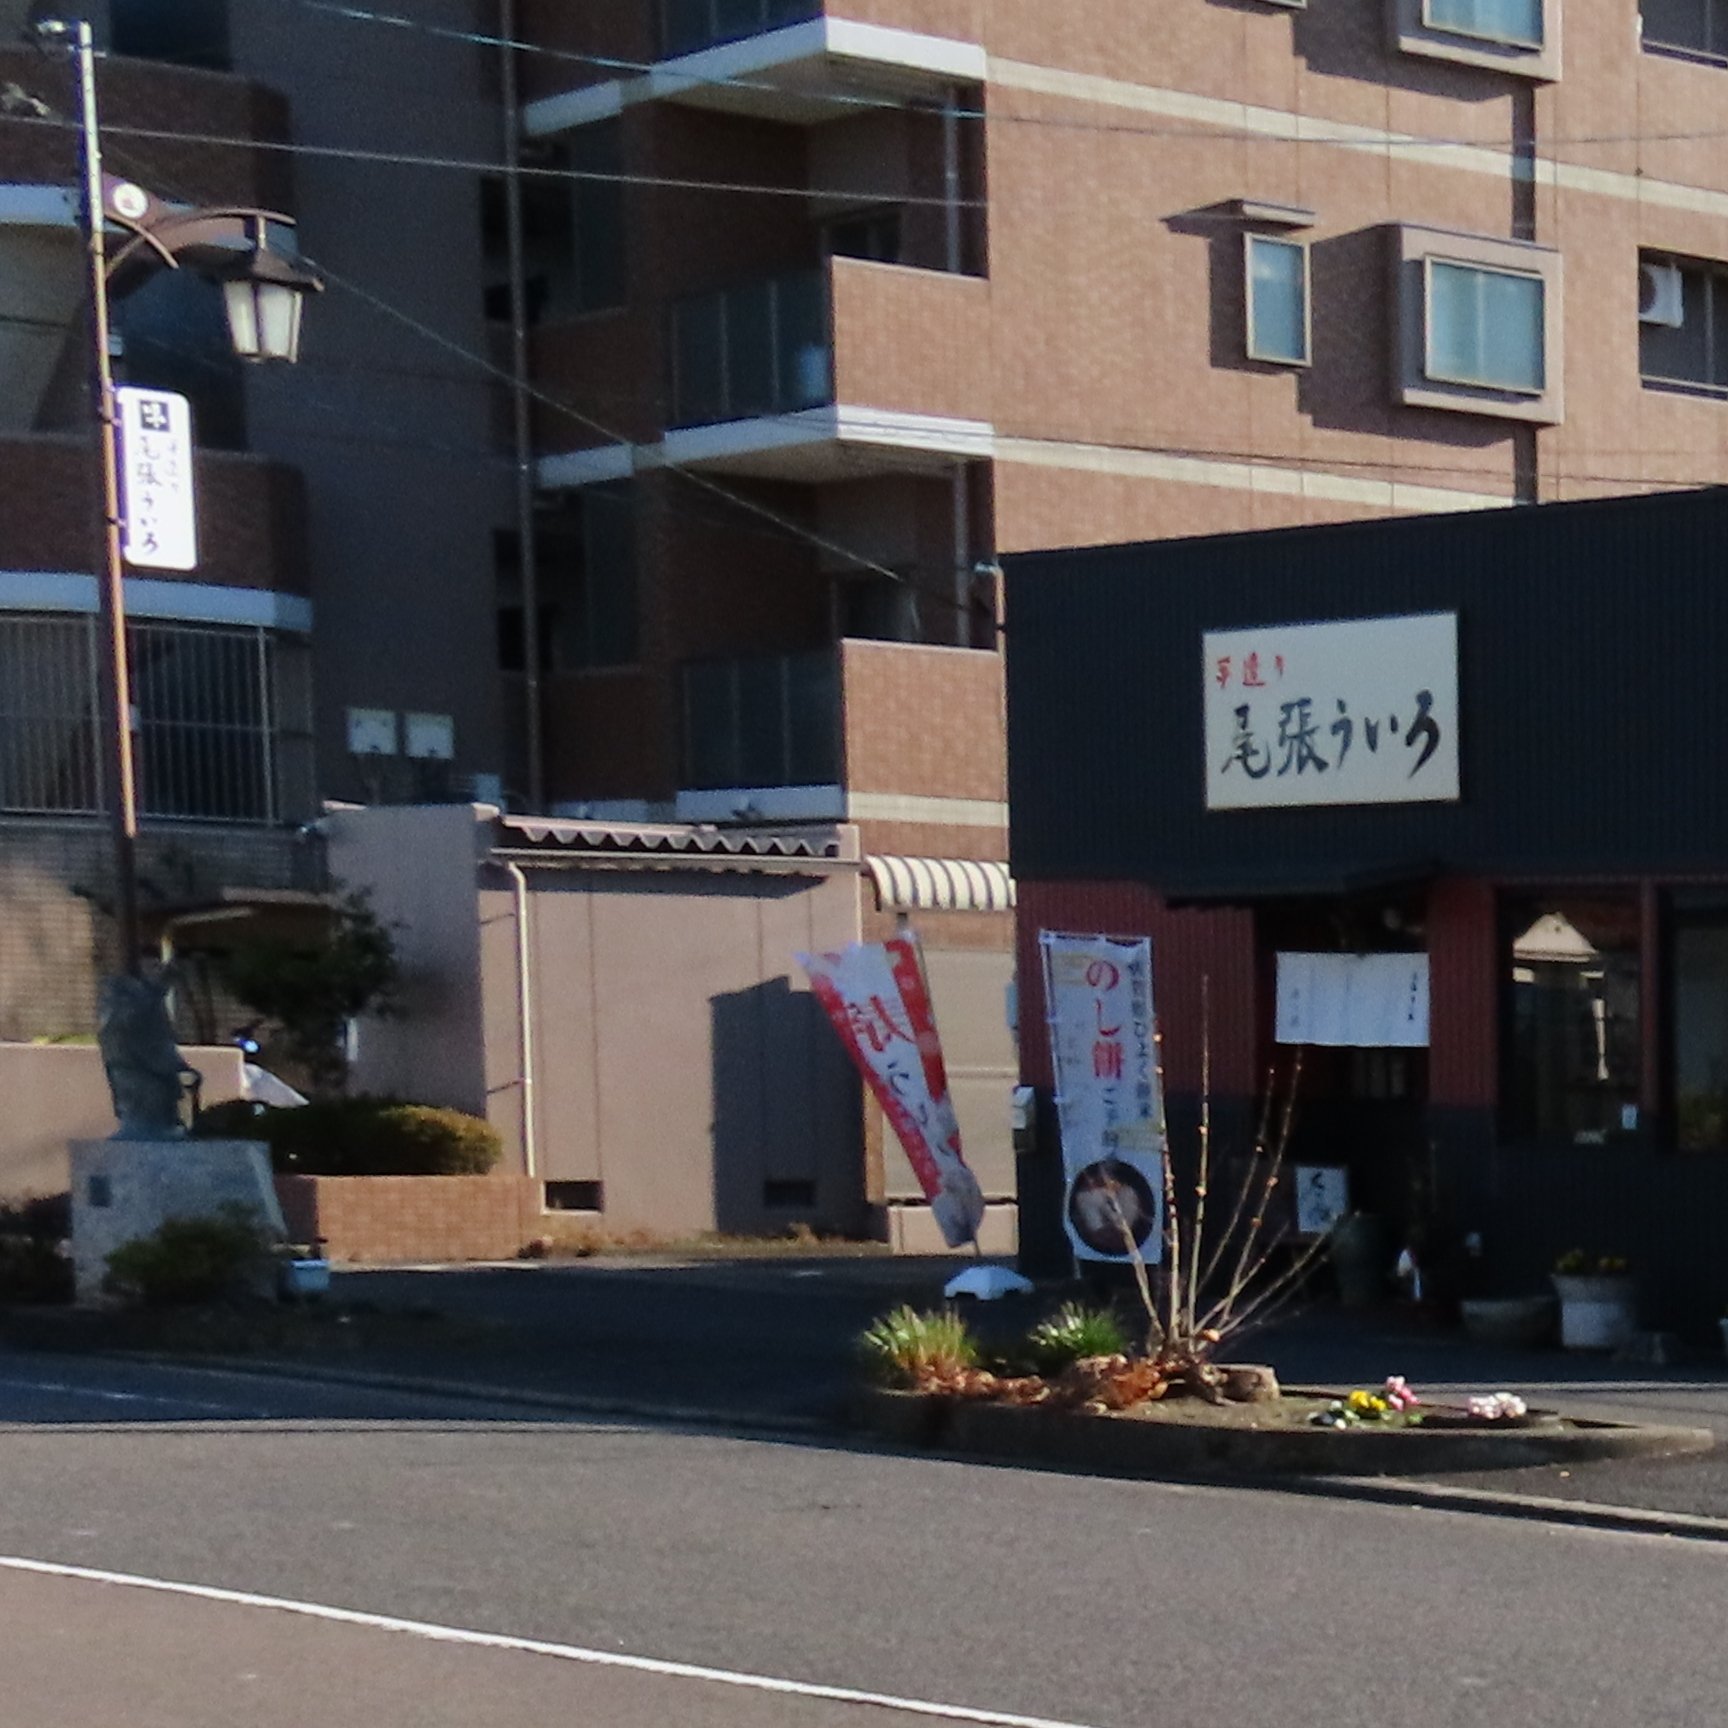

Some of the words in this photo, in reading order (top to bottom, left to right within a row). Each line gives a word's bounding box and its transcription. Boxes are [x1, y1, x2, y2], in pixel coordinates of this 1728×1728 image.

[1220, 689, 1441, 779] 尾張ういろ
